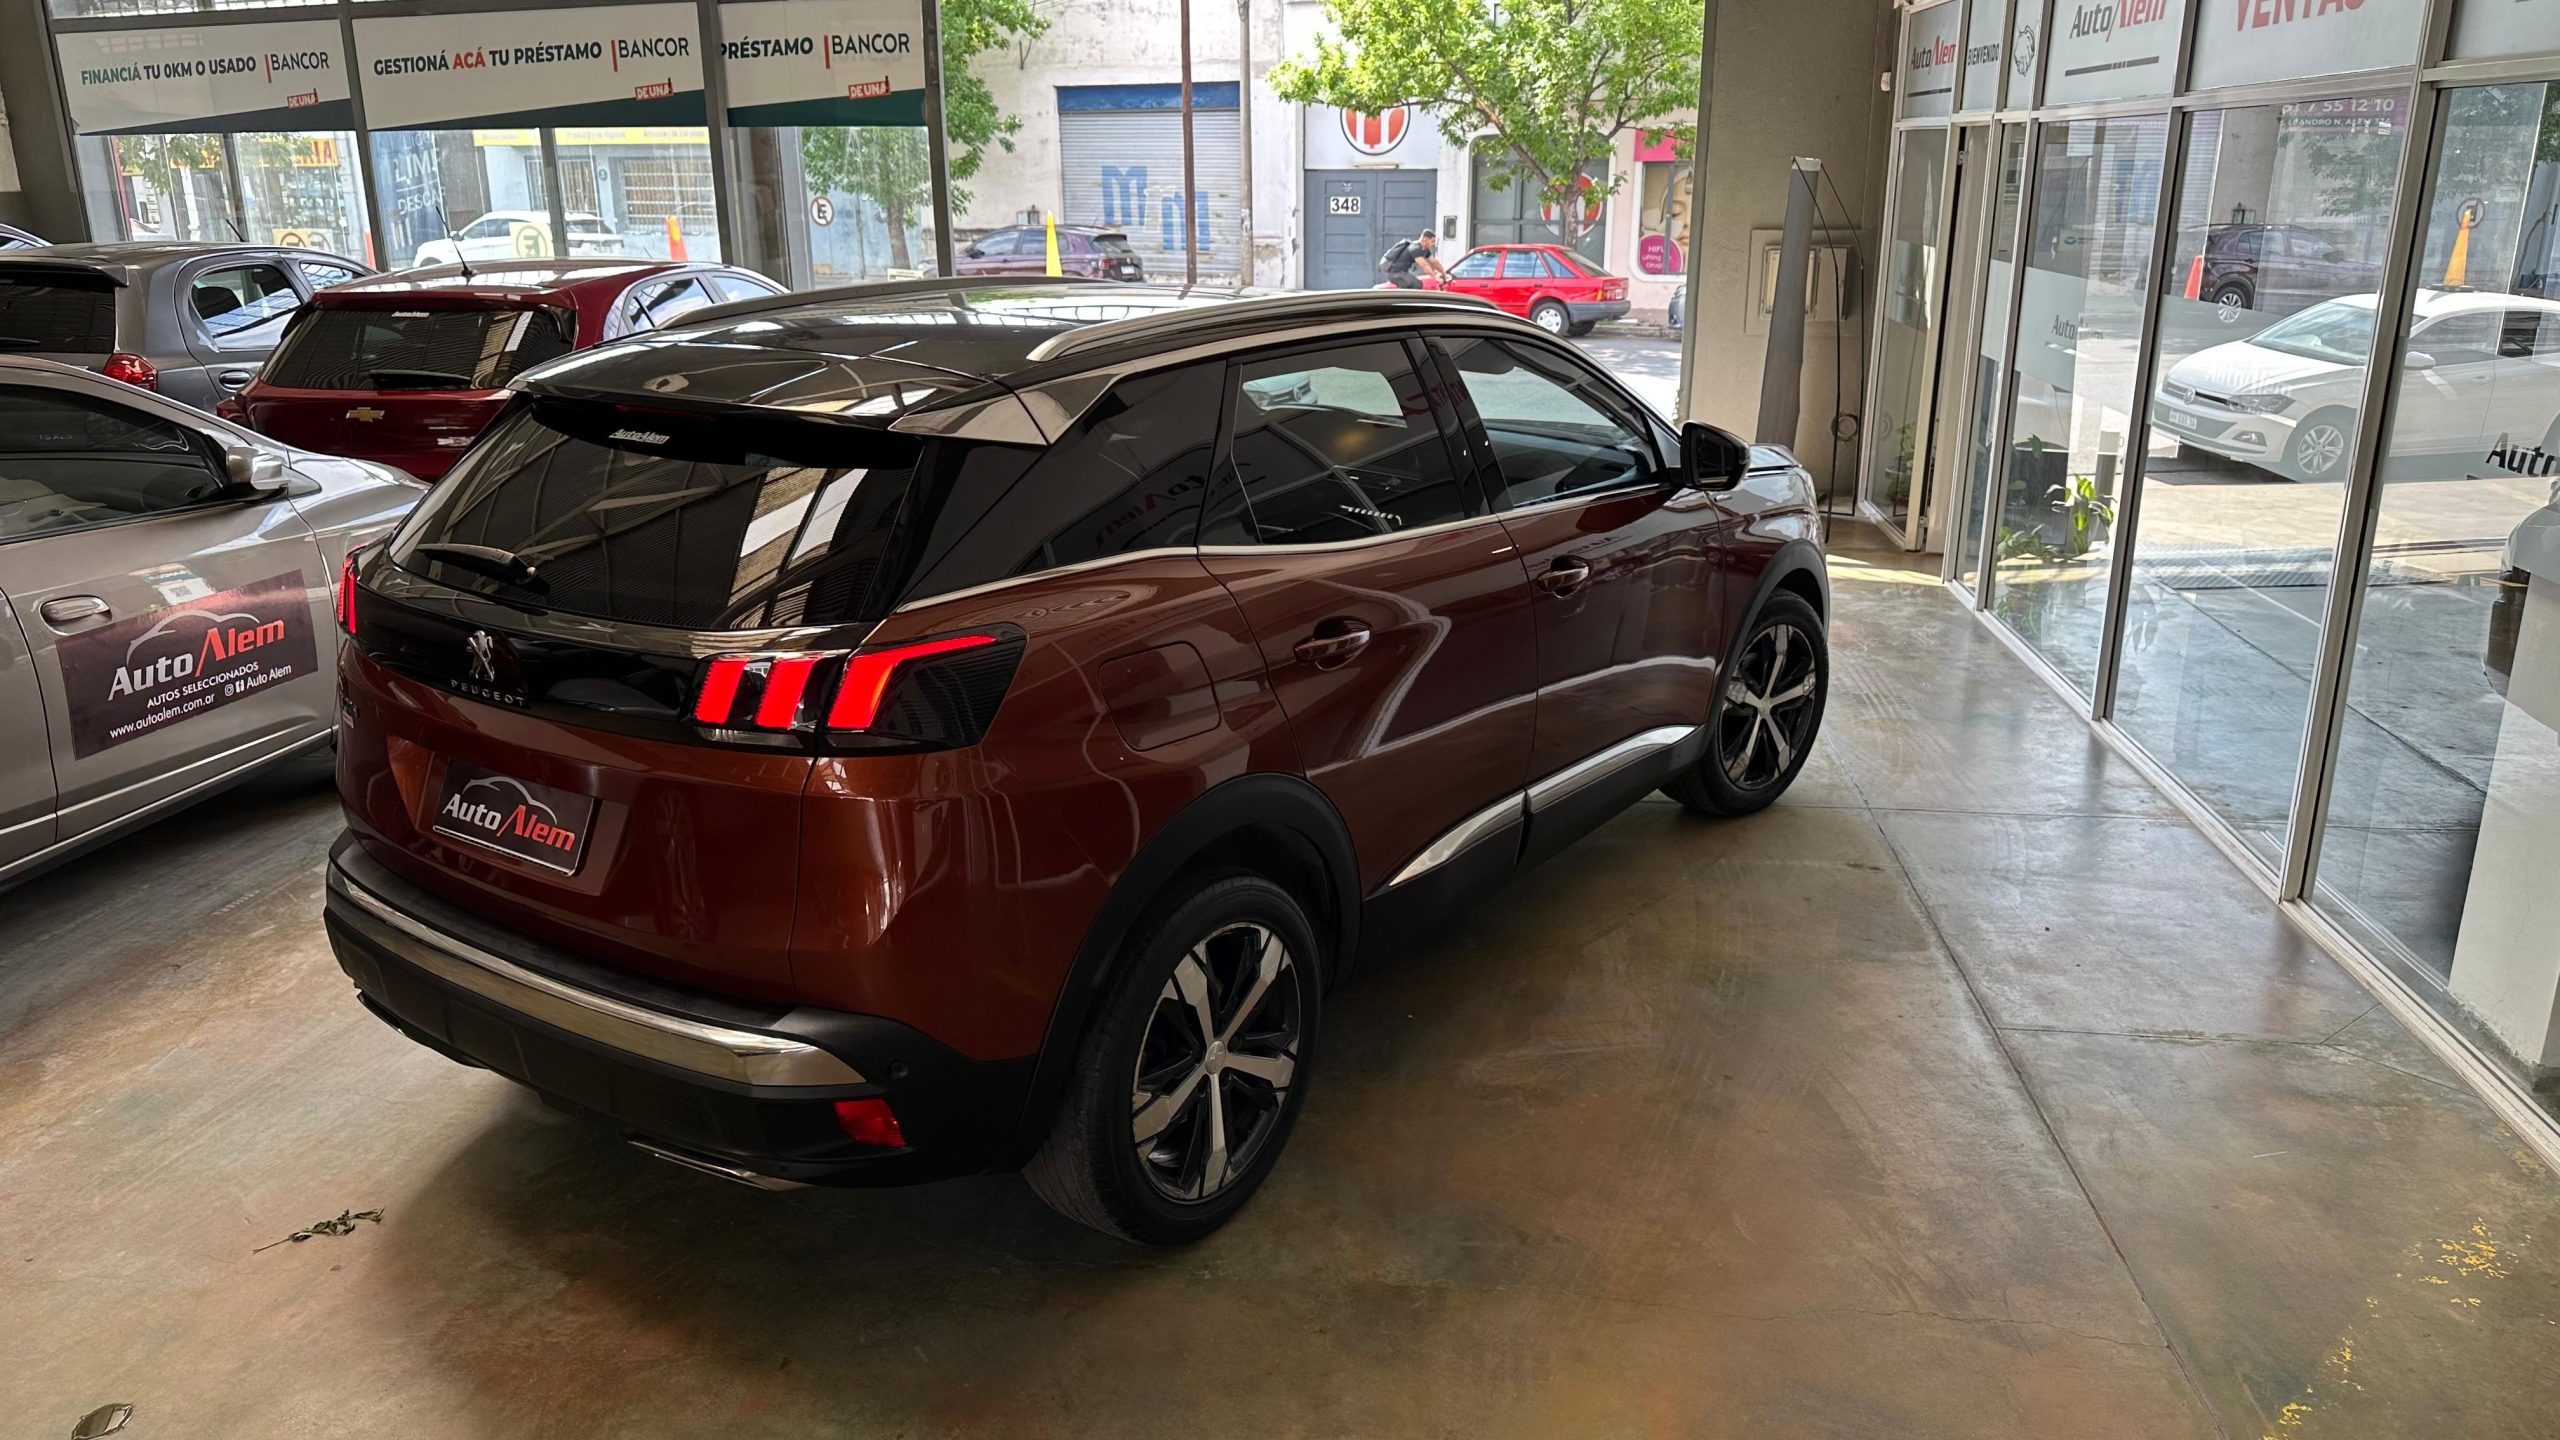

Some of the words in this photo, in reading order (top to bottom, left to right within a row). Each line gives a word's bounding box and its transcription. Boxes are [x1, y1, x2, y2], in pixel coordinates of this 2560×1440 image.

[618, 37, 689, 58] BANCOR
[832, 33, 910, 55] BANCOR
[271, 52, 330, 71] BANCOR
[373, 50, 449, 76] GESTIONÁ
[452, 47, 486, 70] ACÁ
[489, 49, 509, 66] TU
[514, 41, 602, 64] PRÉSTAMO
[81, 62, 142, 85] FINANCIÁ
[144, 65, 161, 80] TU
[195, 60, 206, 76] O
[209, 57, 257, 75] USADO
[636, 87, 649, 99] DE
[850, 86, 863, 97] DE
[2351, 99, 2368, 112] 12
[2374, 98, 2395, 112] 10
[1331, 198, 1360, 213] 348
[147, 691, 181, 709] AUTOS
[182, 661, 259, 696] SELECCIONADOS
[246, 675, 268, 689] Auto
[269, 663, 292, 681] Alem
[451, 679, 525, 707] PEUGEOT
[109, 693, 215, 739] www.autoalem.com.ar
